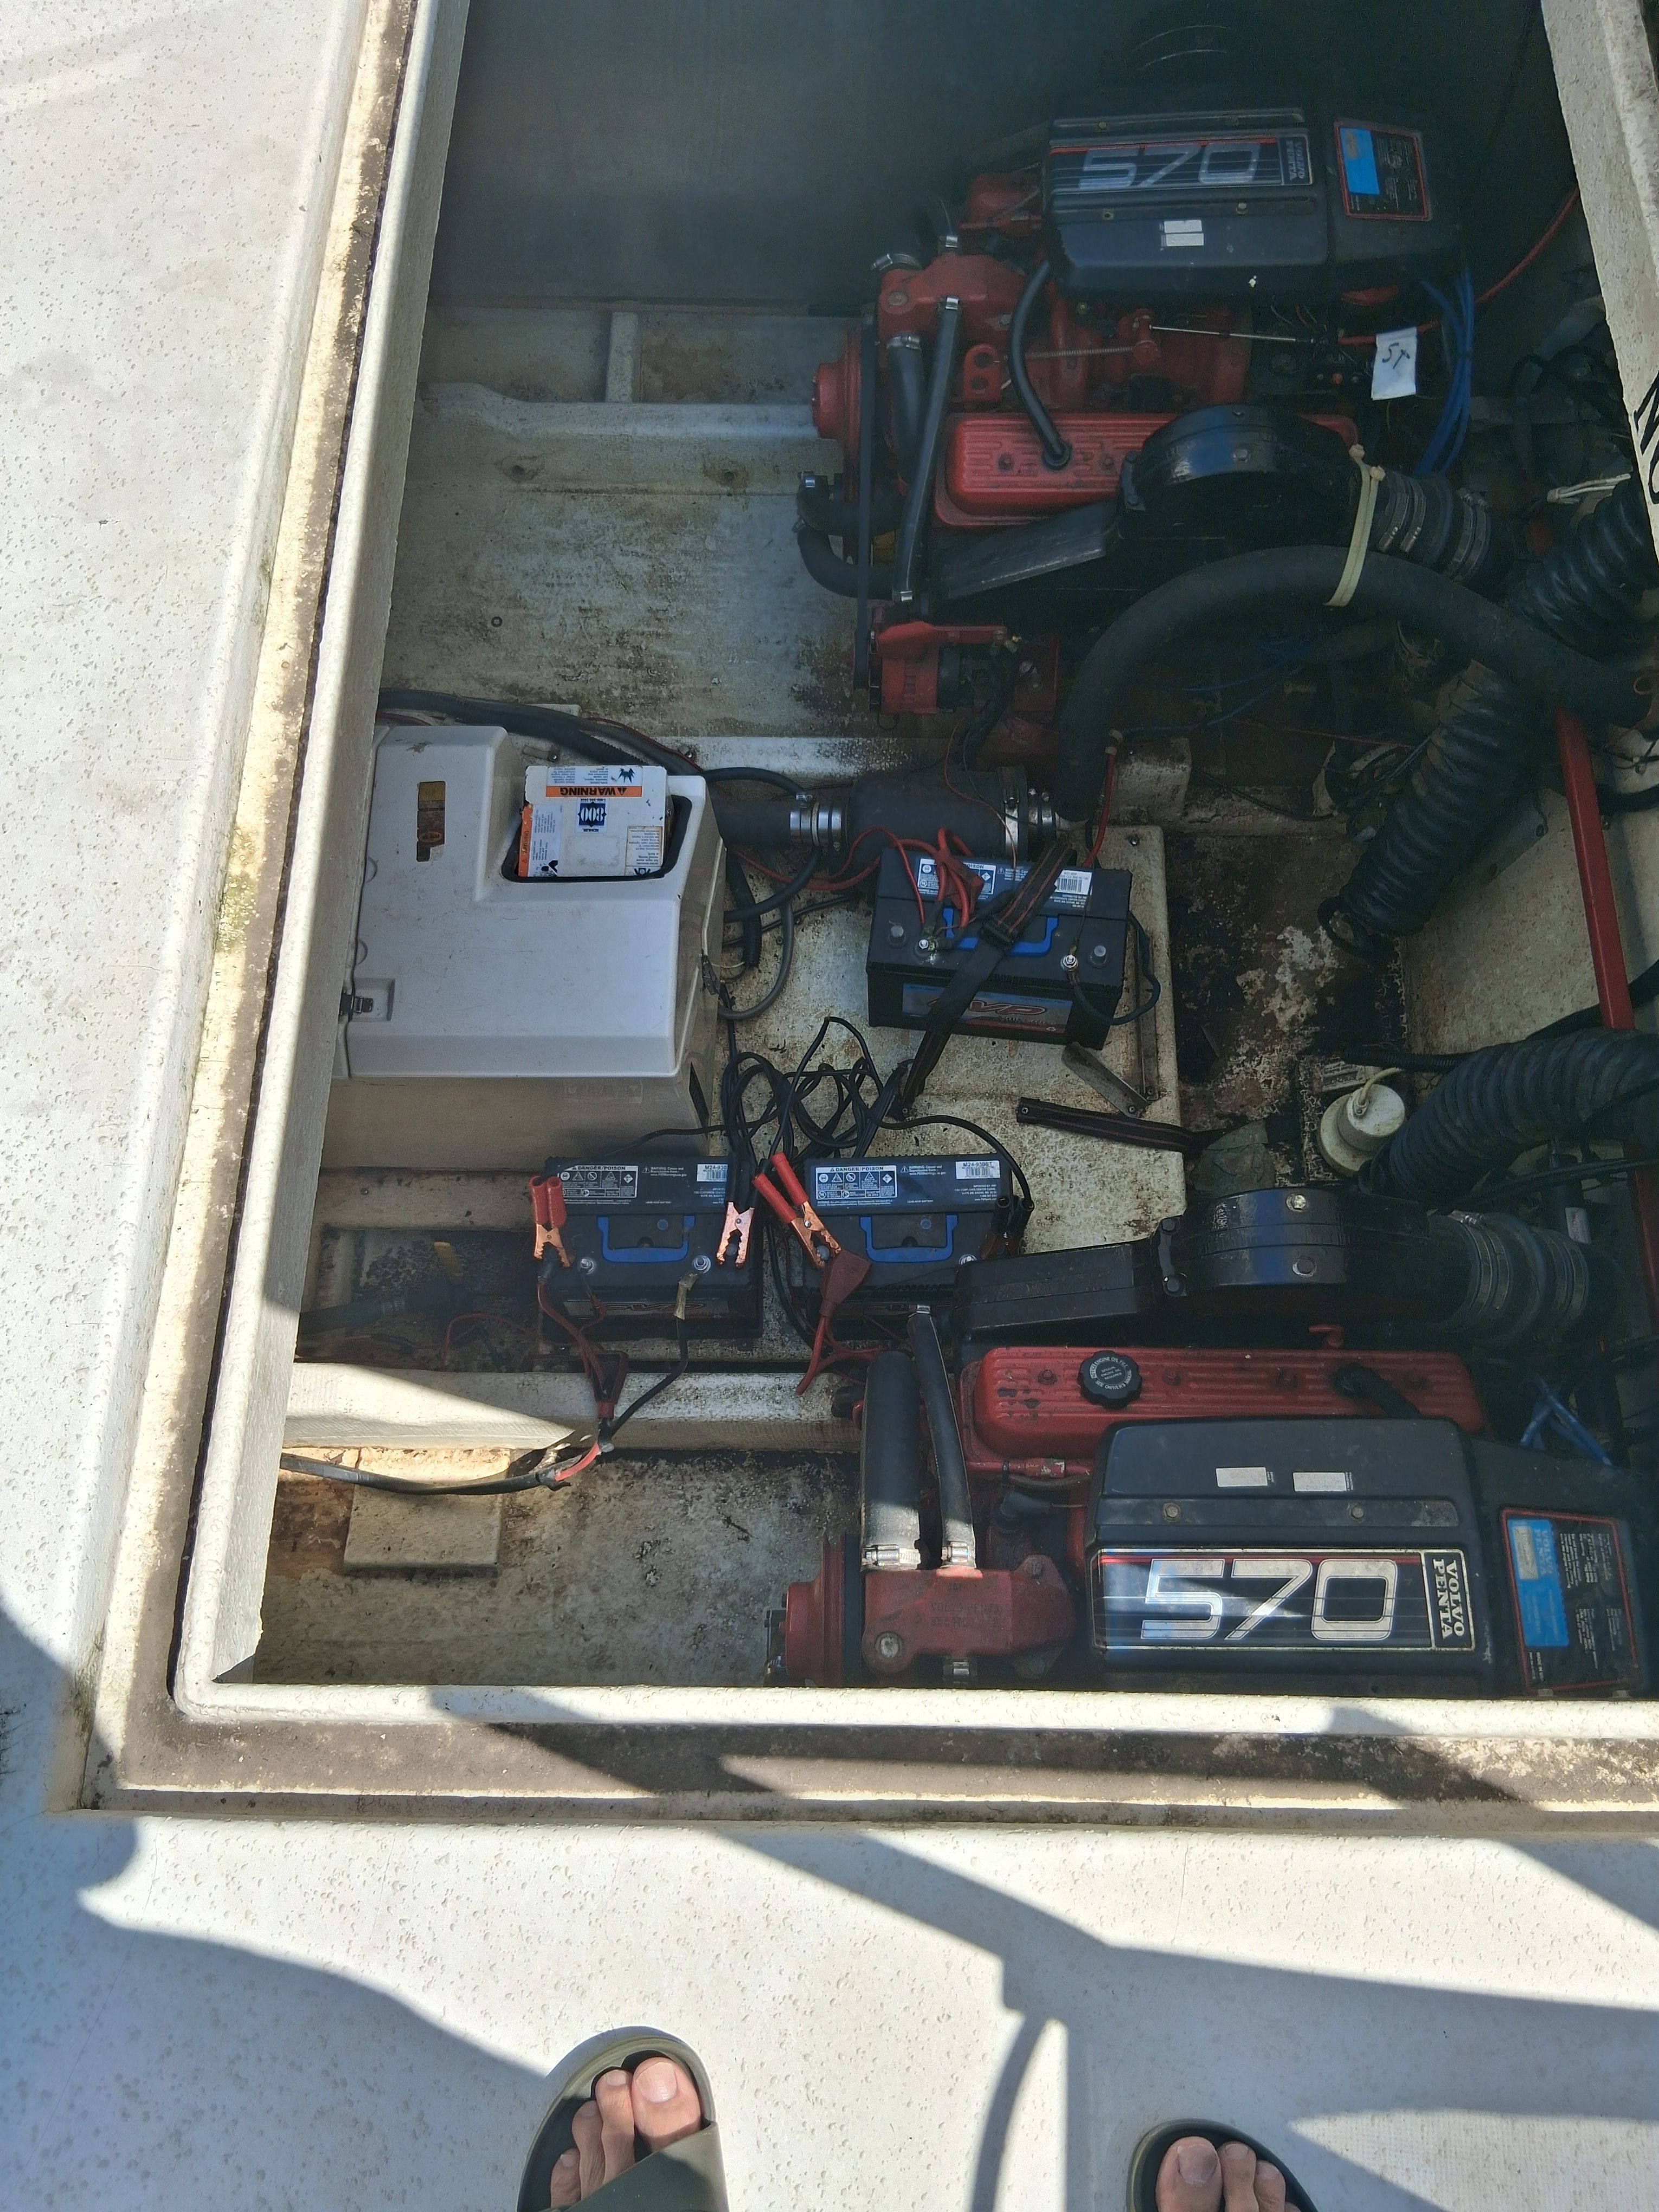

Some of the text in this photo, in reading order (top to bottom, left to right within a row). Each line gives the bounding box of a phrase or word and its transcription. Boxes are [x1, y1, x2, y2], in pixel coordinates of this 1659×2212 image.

[1079, 142, 1262, 189] 570
[560, 787, 616, 796] WARNING
[581, 807, 605, 822] 800
[1090, 1364, 1098, 1379] NOTICE
[1094, 1356, 1110, 1365] ENGINE
[1140, 1559, 1398, 1641] 570
[1433, 1558, 1453, 1639] PENTA
[1446, 1559, 1464, 1637] VOLVO
